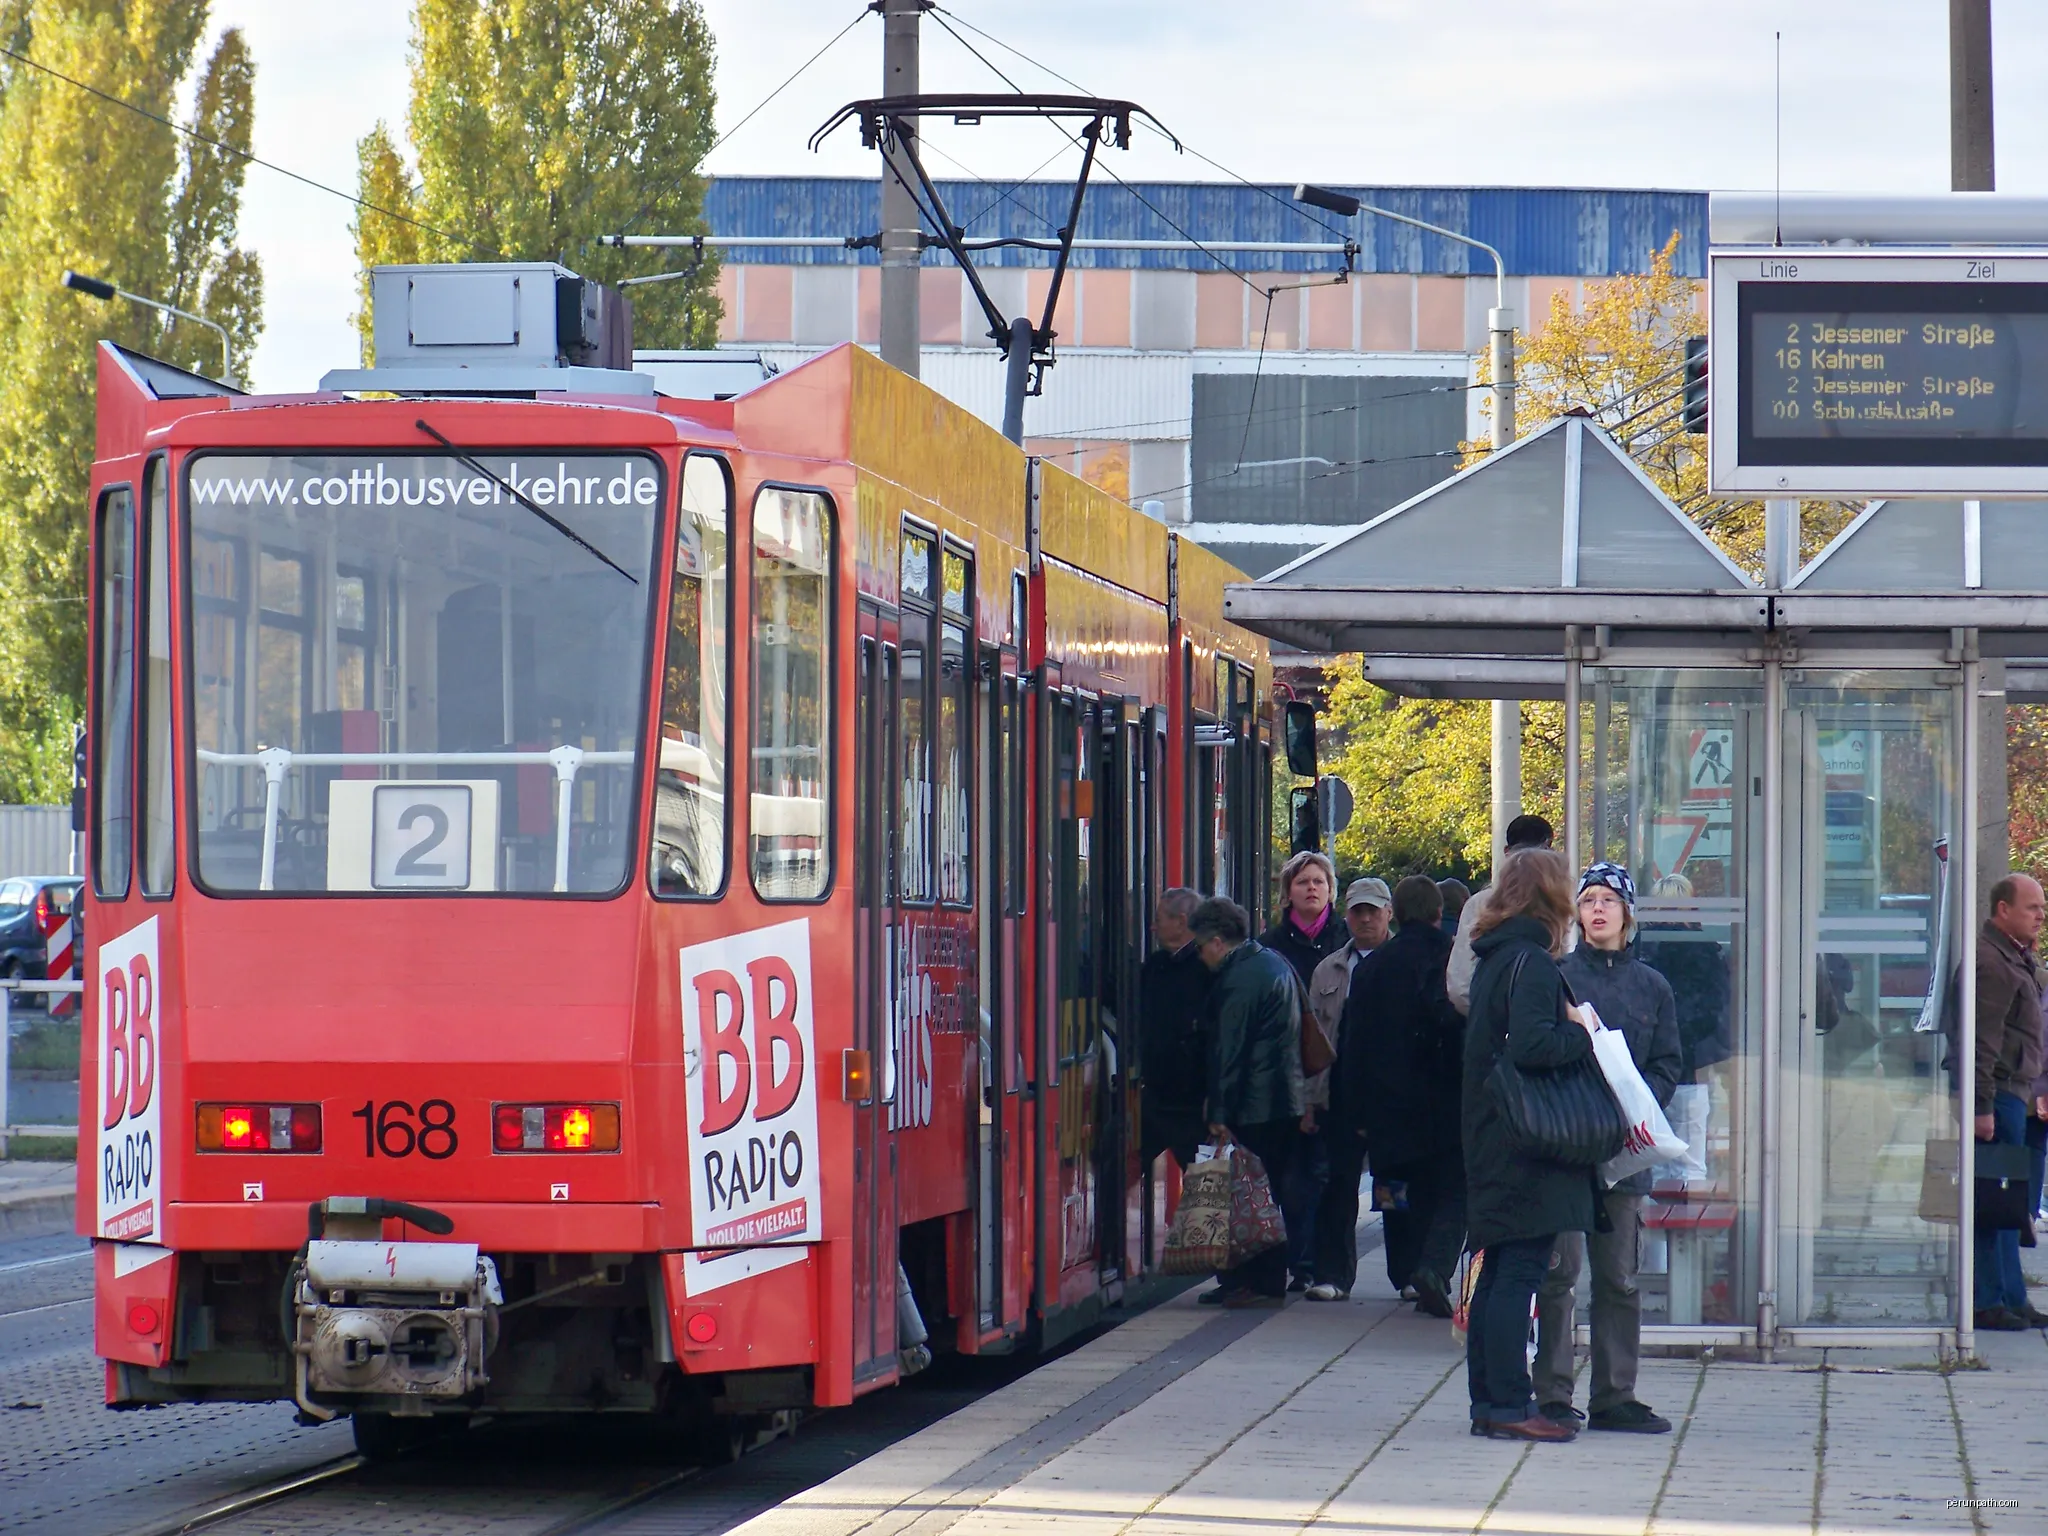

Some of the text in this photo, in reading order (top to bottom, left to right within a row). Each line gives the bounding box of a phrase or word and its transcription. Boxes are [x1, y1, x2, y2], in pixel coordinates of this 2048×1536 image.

[1760, 261, 1996, 279] Linie Ziel
[1787, 324, 1996, 349] 2 Jessener Straße
[1775, 349, 1885, 370] 16 Kahren
[1787, 376, 1800, 394] 2
[1812, 376, 1908, 395] Jessener
[190, 462, 658, 506] www.cottbusverkehr.de
[394, 803, 449, 877] 2
[103, 952, 154, 1131] BB
[692, 955, 804, 1138] BB
[352, 1098, 459, 1160] 168
[708, 1206, 805, 1246] VOLL DIE VIELFALT.
